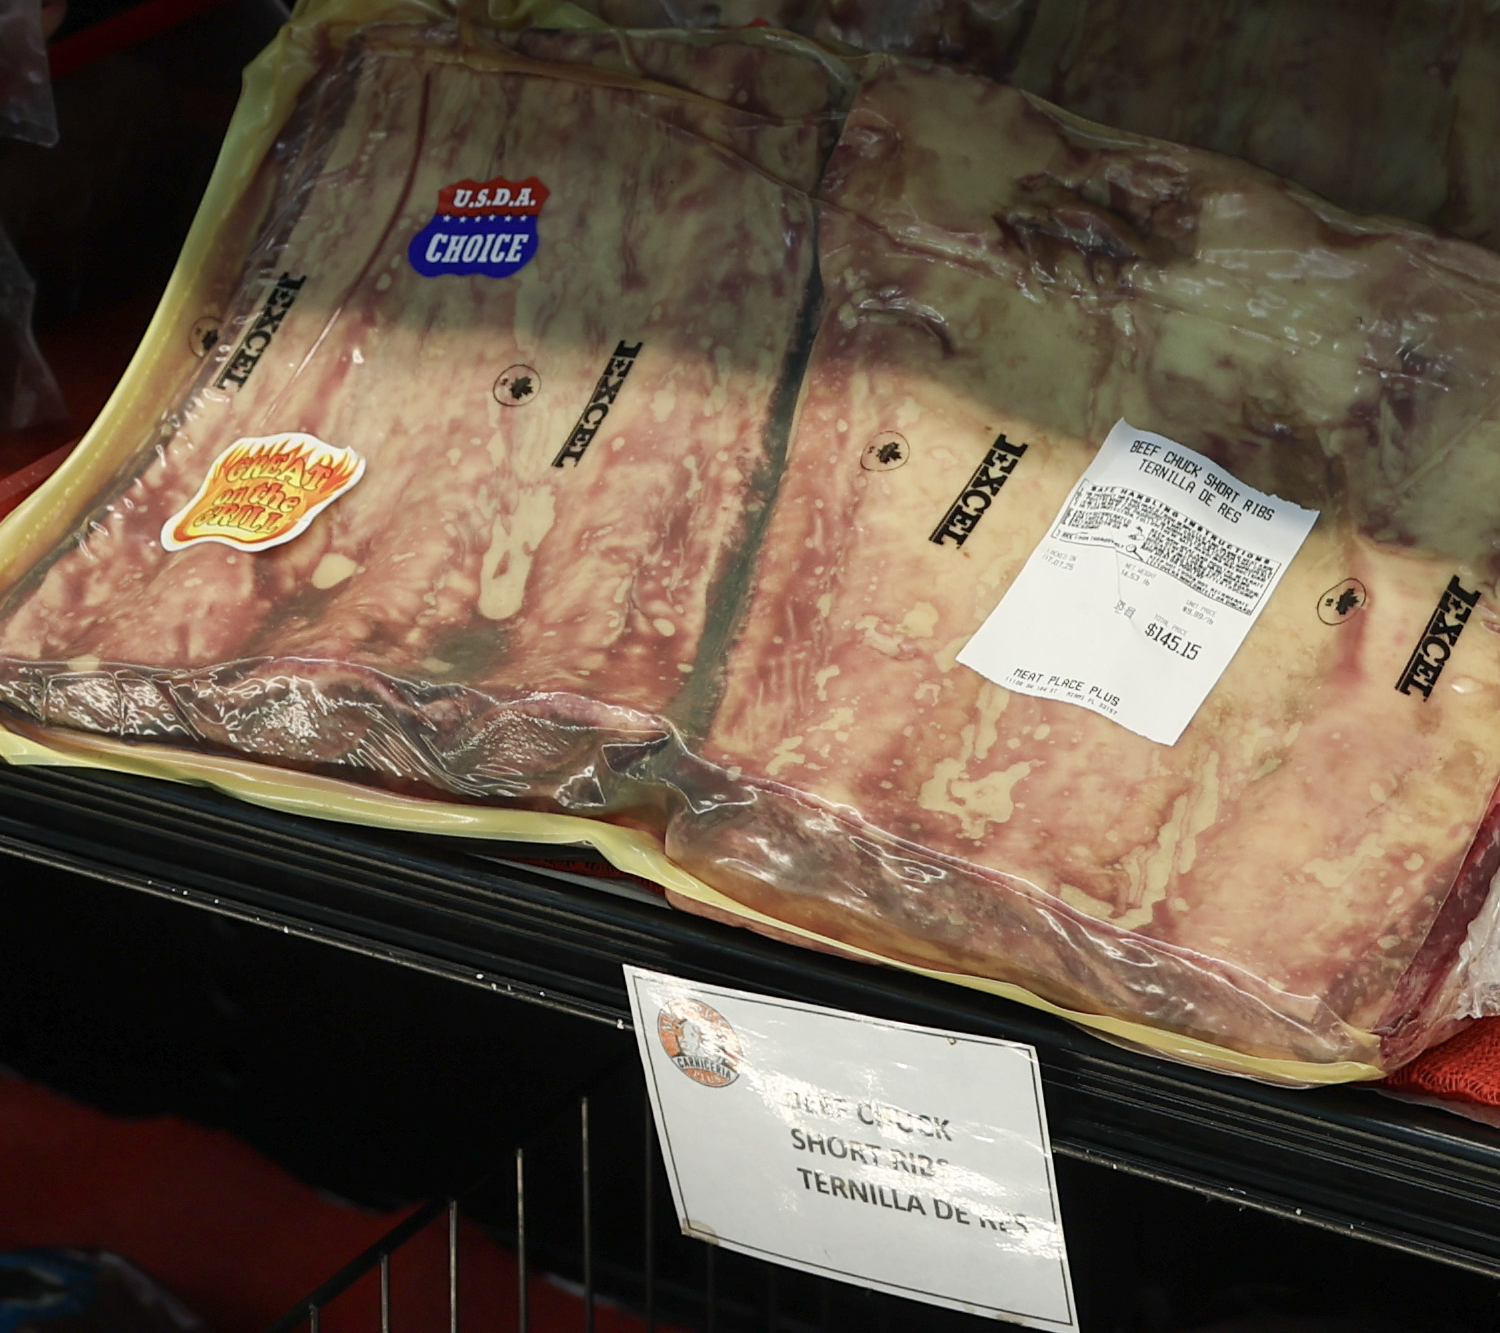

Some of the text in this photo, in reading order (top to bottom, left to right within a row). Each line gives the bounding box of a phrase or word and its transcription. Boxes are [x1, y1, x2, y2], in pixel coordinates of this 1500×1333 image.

[453, 187, 537, 209] U.S.D.A.
[425, 231, 530, 265] CHOICE
[213, 270, 308, 394] EXCEL
[550, 339, 645, 470] EXCEL
[225, 451, 333, 493] GREAT
[928, 432, 1030, 552] EXCEL
[1129, 439, 1276, 522] BEEF CHUCK SHORT RIBS
[1138, 457, 1243, 526] TERNILLA DE RES
[212, 481, 301, 514] on the
[192, 503, 284, 537] GRILL
[1144, 623, 1202, 661] $145.15
[1394, 573, 1483, 700] EXCEL
[1012, 668, 1122, 707] MEAT PLACE PLUS
[676, 1052, 732, 1082] CARNICERIA
[791, 1128, 881, 1168] SHORT
[796, 1168, 927, 1217] TERNILLA
[933, 1197, 970, 1226] DE
